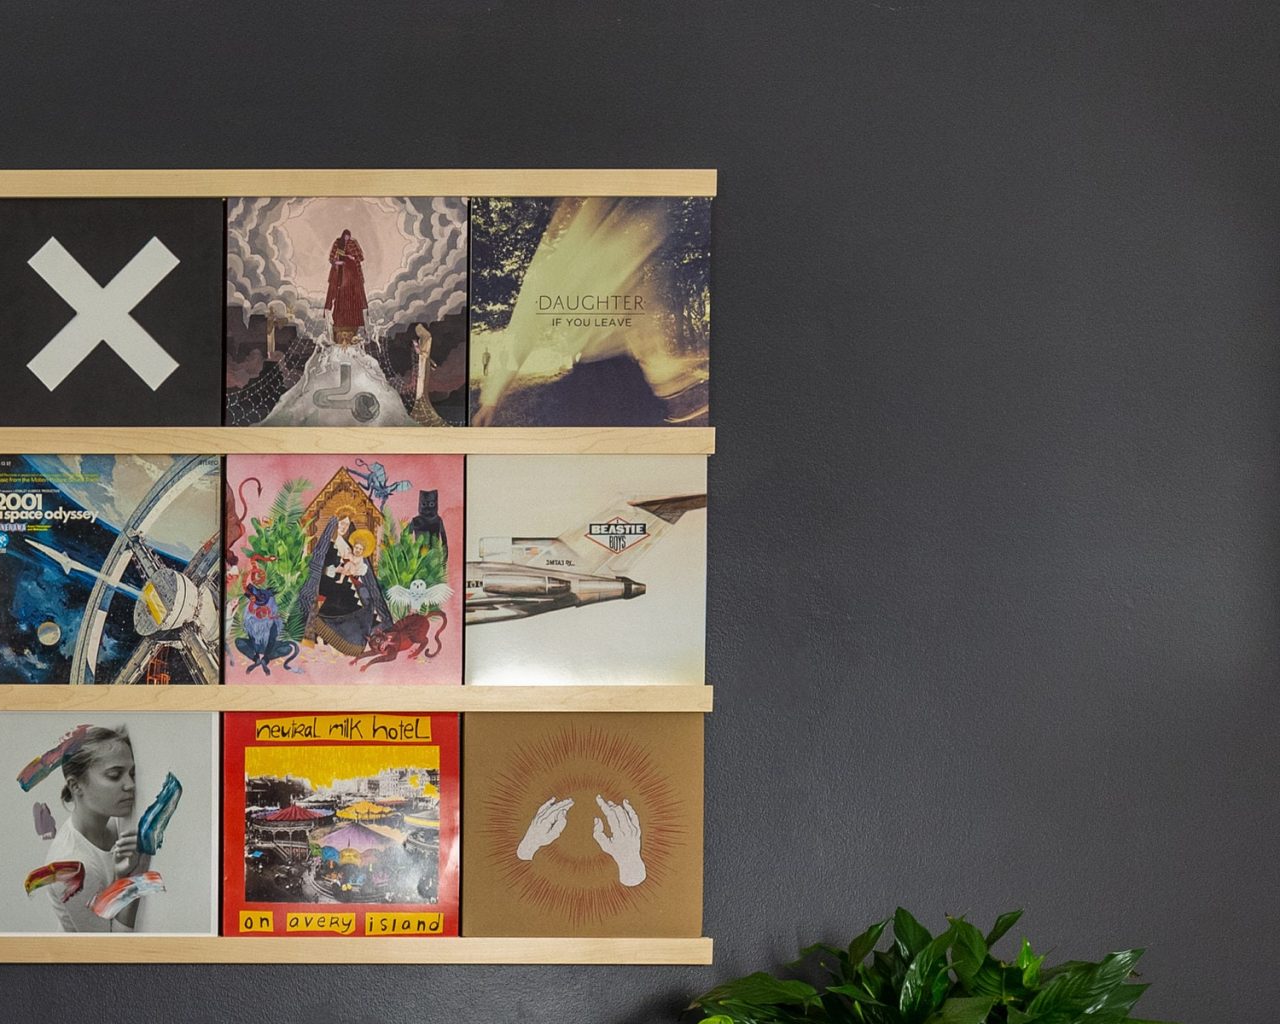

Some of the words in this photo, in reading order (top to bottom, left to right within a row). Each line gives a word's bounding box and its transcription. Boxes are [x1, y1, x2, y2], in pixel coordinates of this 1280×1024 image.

[539, 295, 645, 311] DAUGHTER
[552, 318, 562, 327] IF
[566, 318, 590, 327] YOU
[594, 318, 632, 327] LEAVE
[4, 511, 43, 523] space
[44, 506, 99, 523] odyssey
[591, 525, 644, 534] BEASTIE
[609, 535, 626, 551] BOYS
[244, 916, 271, 930] on
[369, 913, 441, 932] island
